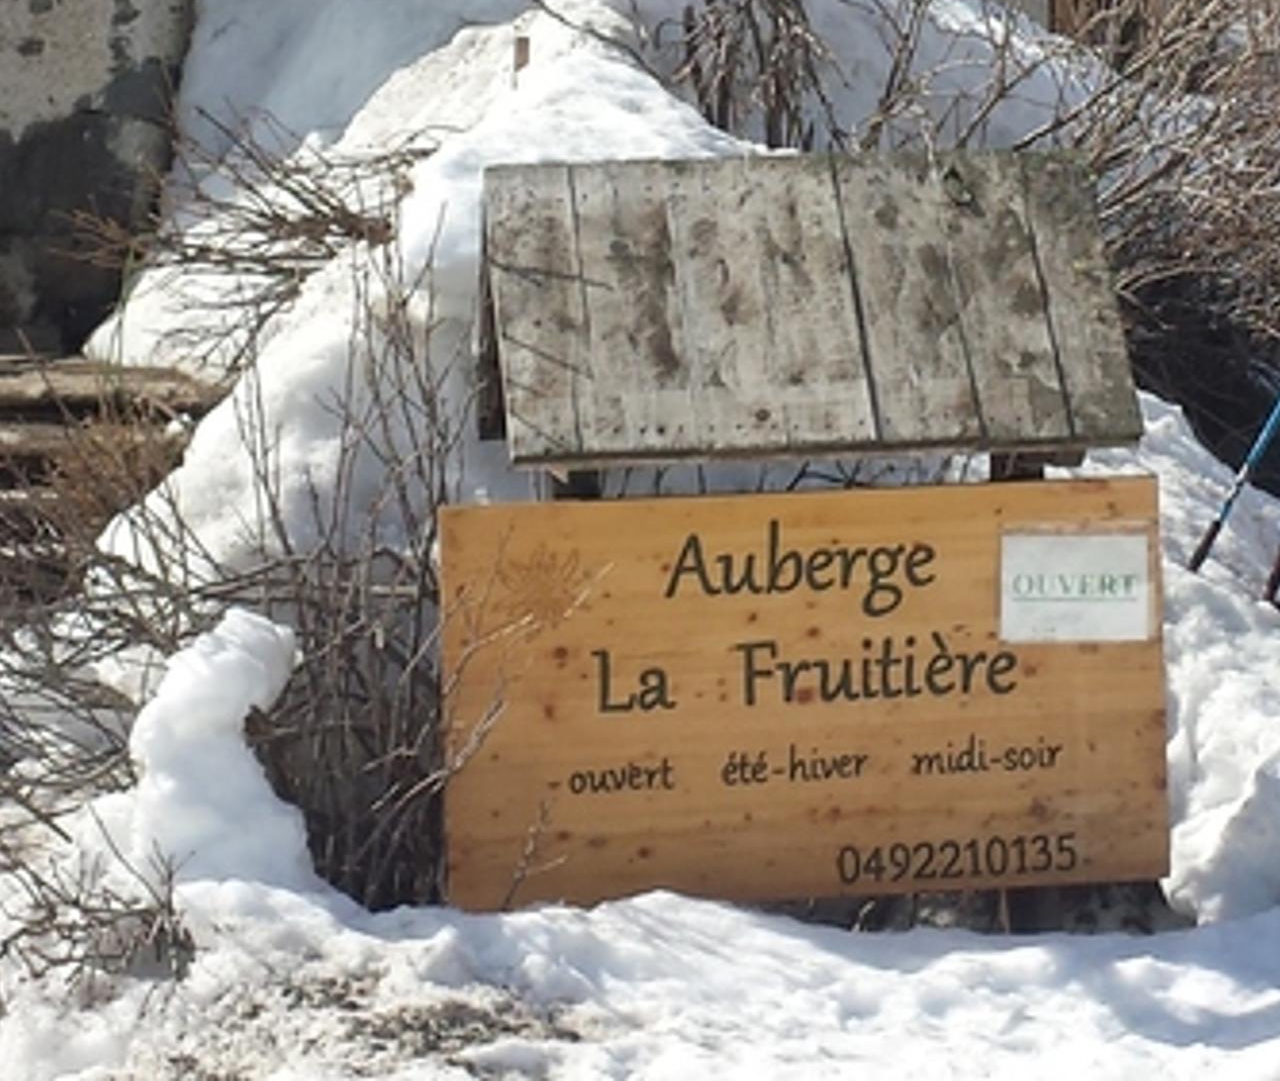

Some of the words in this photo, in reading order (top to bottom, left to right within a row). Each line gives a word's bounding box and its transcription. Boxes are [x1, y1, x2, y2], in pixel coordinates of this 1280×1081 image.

[665, 520, 937, 616] Auberge
[1012, 573, 1138, 595] OUVERT
[593, 649, 676, 713] La
[736, 632, 1017, 705] Fruitière
[569, 758, 675, 794] ouvert
[721, 744, 868, 786] été-hiver
[911, 735, 1064, 776] midi-soir
[836, 831, 1077, 885] 0492210135
